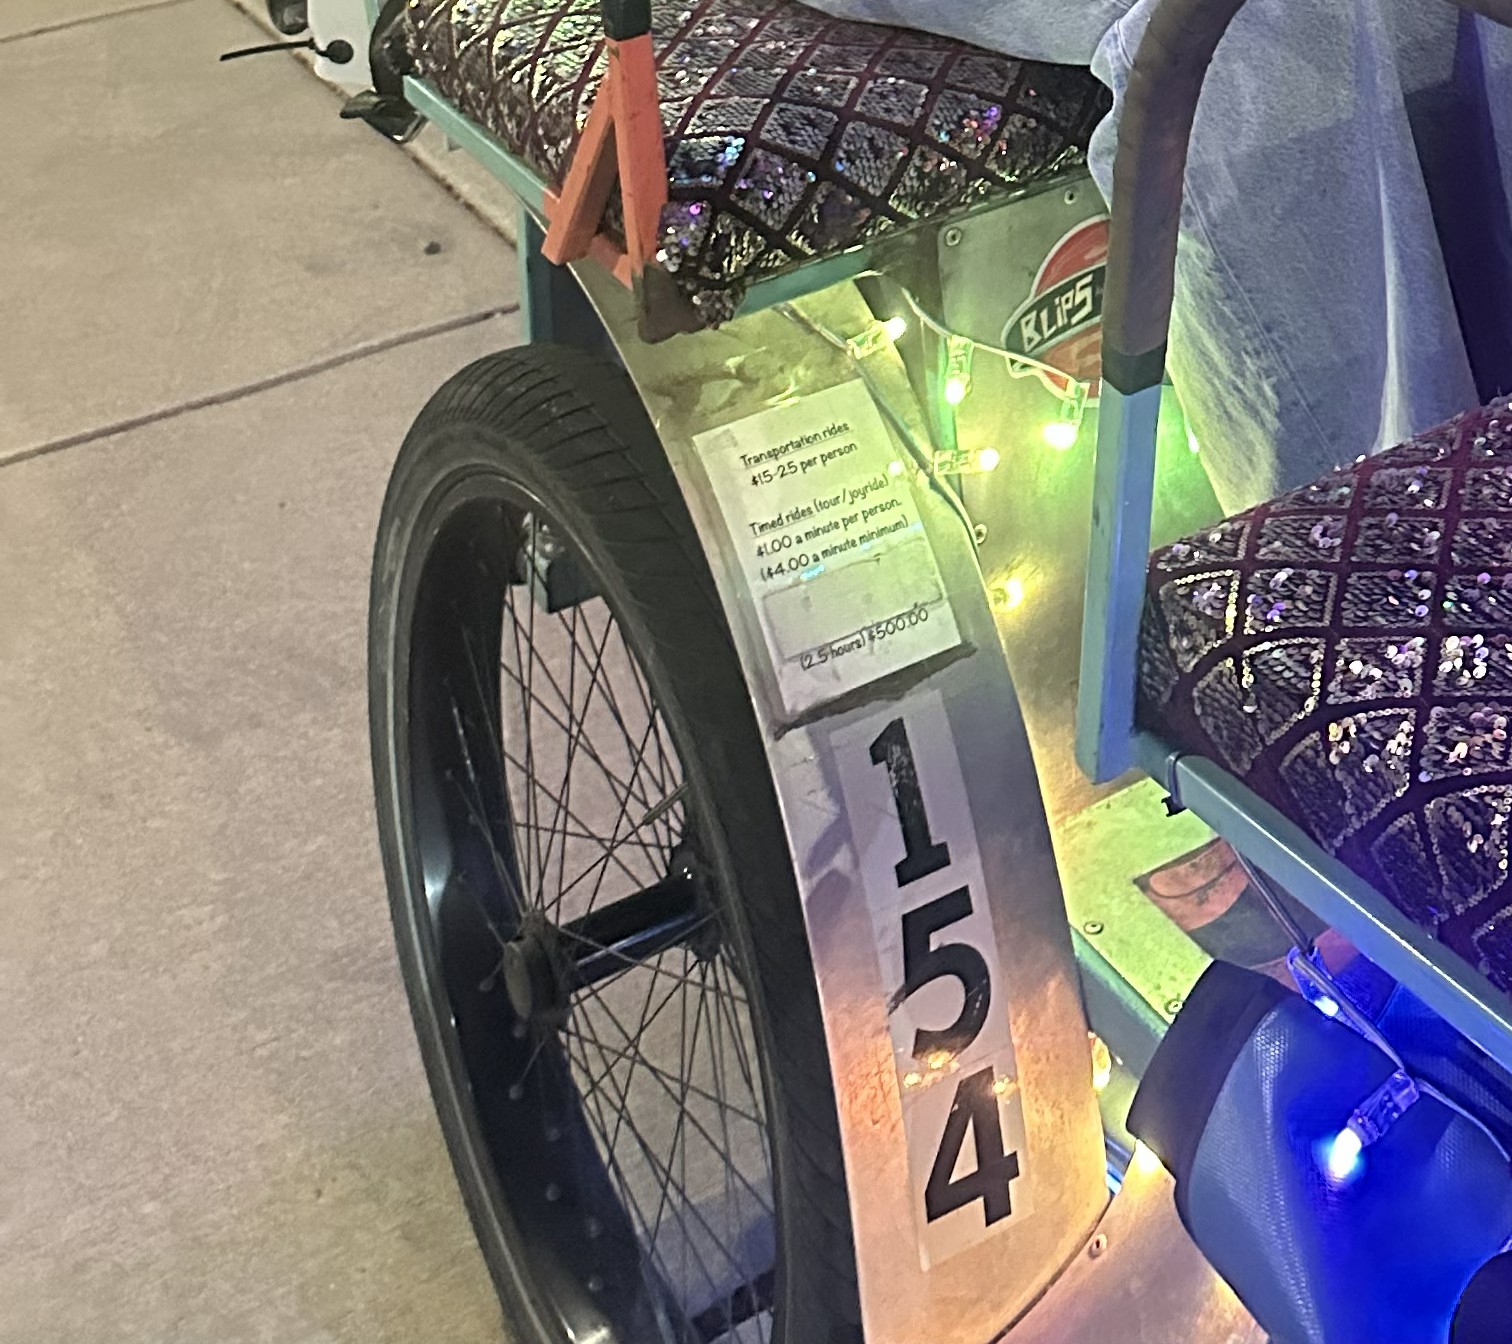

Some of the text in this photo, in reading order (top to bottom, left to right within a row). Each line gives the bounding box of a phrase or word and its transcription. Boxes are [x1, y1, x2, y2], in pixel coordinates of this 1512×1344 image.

[739, 422, 850, 468] Transportation rides
[751, 441, 857, 487] $15-25 per person
[749, 514, 784, 537] Timed
[785, 504, 814, 524] rides
[756, 535, 793, 559] $1.00
[795, 532, 803, 545] a
[804, 518, 840, 542] minute
[842, 510, 860, 531] per
[760, 552, 810, 583] ($4.00
[821, 537, 858, 560] minute
[858, 514, 909, 546] minimum)
[868, 606, 930, 642] $500.00
[870, 715, 1021, 1229] 154
